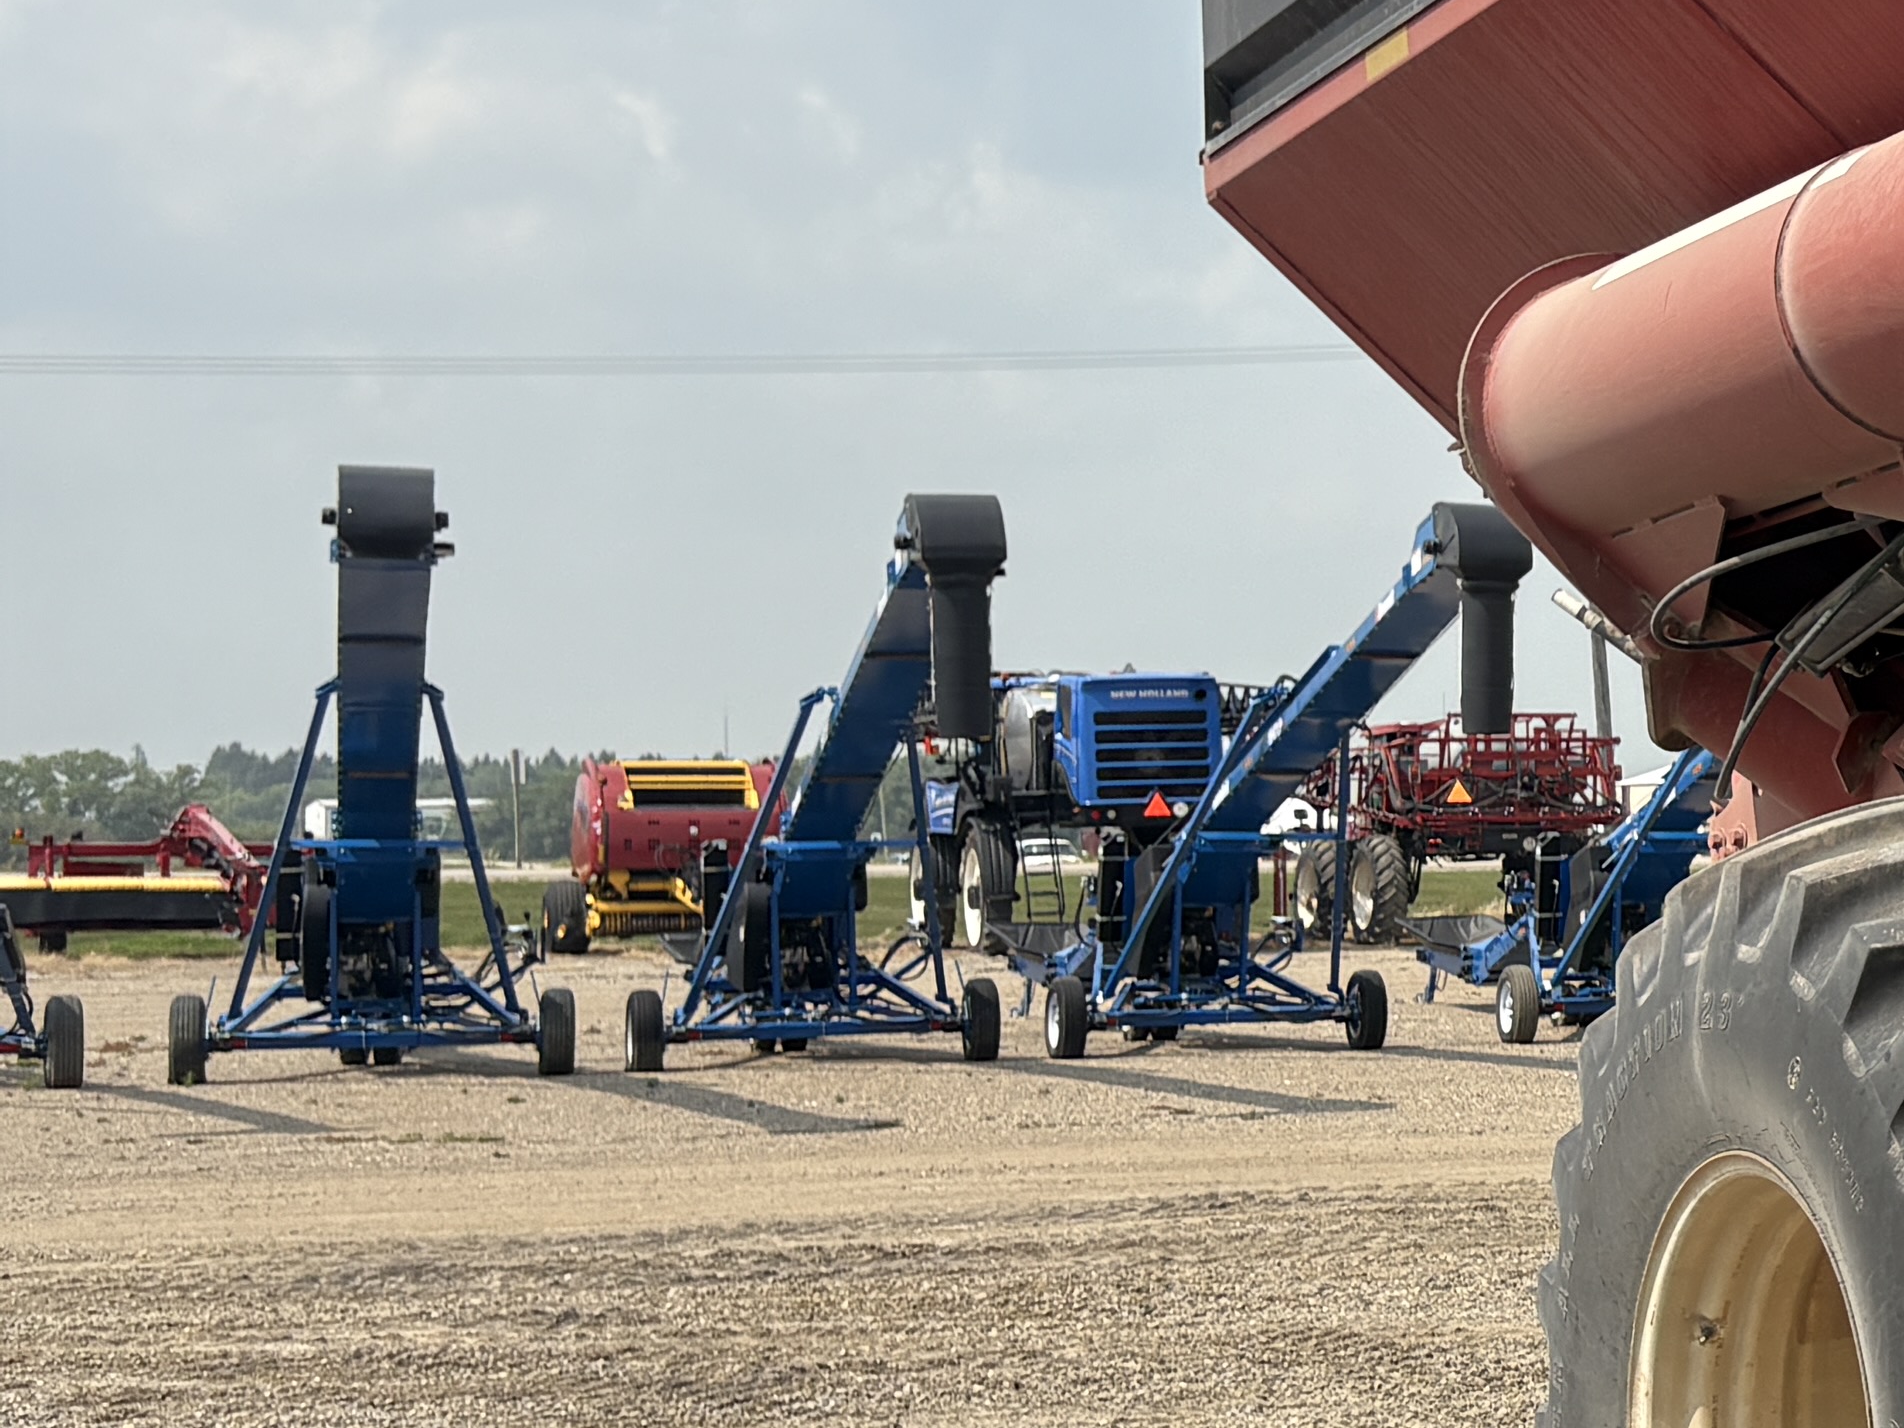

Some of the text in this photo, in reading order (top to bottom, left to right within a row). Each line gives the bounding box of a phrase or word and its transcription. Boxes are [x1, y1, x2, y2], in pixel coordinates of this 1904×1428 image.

[1110, 687, 1190, 700] NEW HOLLAND
[1581, 992, 1684, 1183] TRACTION
